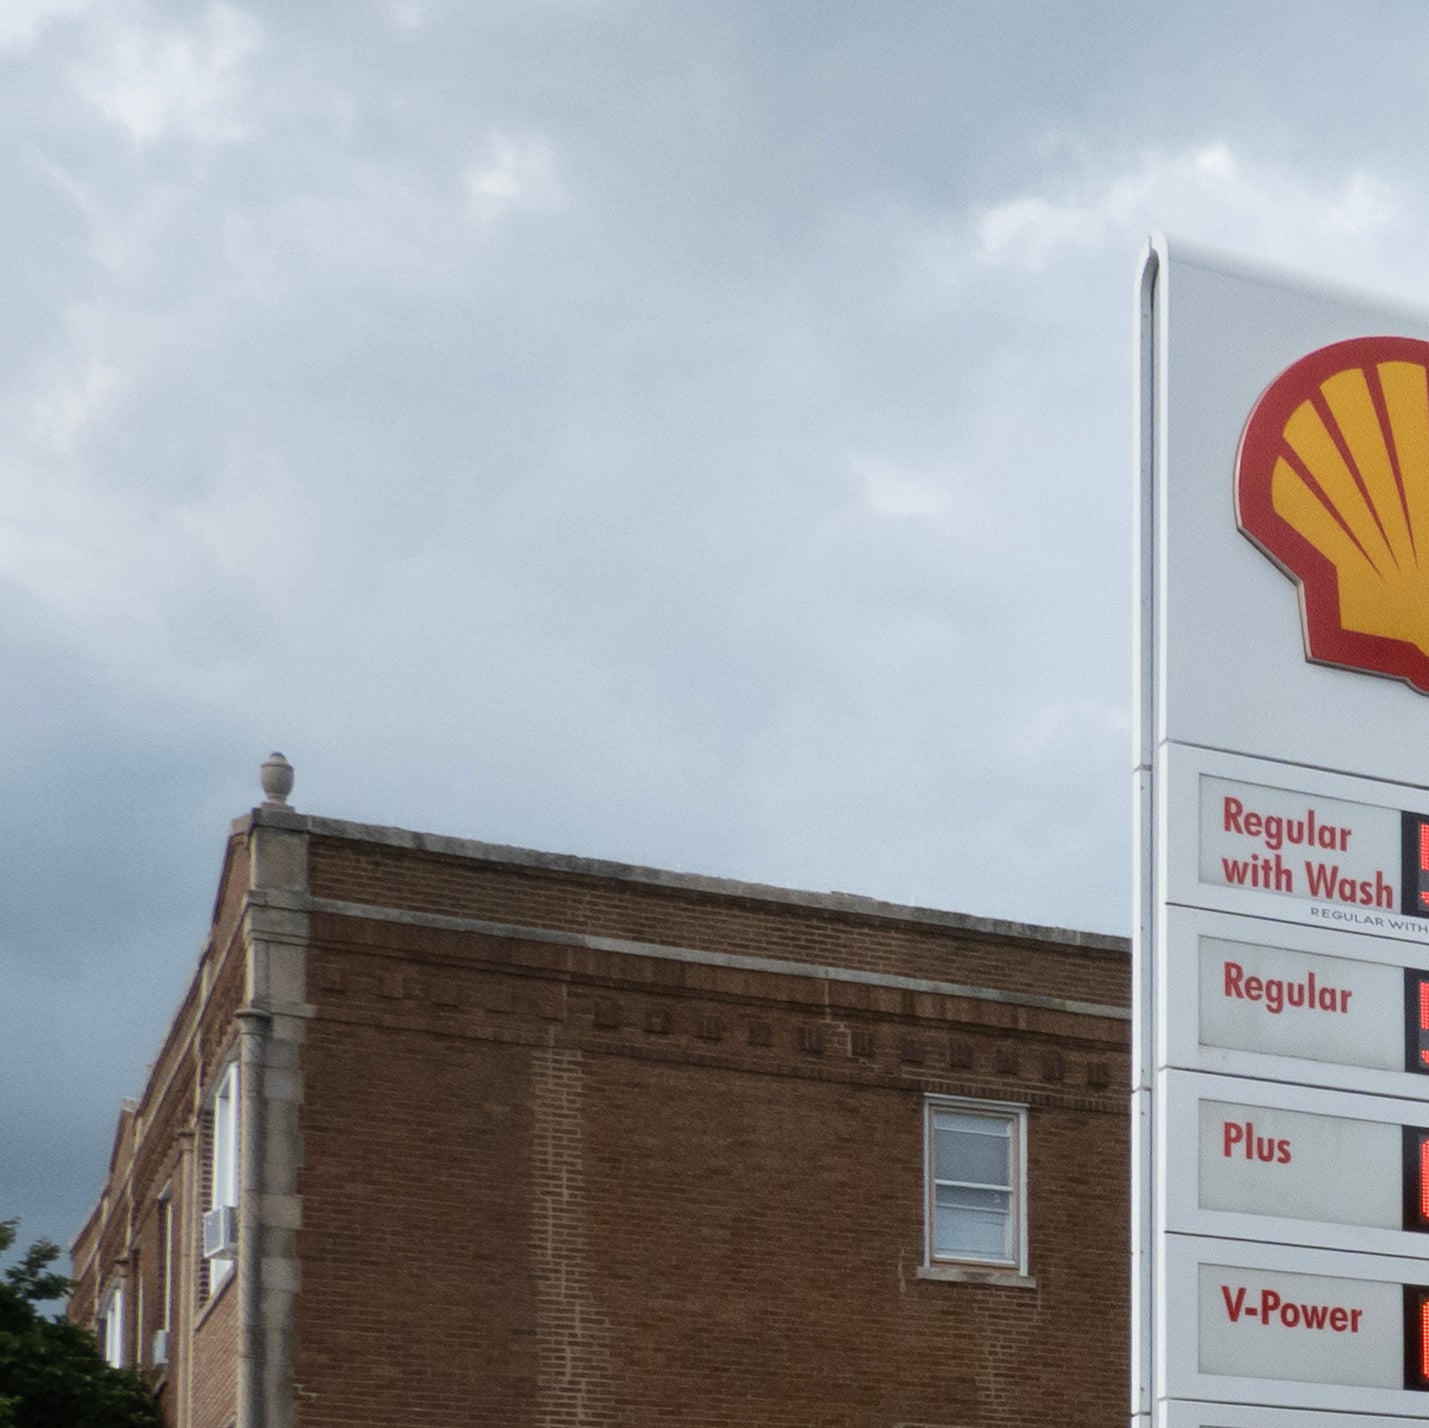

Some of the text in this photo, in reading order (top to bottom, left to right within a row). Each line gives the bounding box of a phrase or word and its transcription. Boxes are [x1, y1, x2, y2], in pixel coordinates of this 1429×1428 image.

[1222, 795, 1353, 853] Regular
[1222, 855, 1395, 911] with Wash
[1309, 906, 1385, 929] REGULAR
[1387, 918, 1429, 936] WITH
[1223, 961, 1353, 1015] Regular
[1222, 1121, 1293, 1165] Plus
[1220, 1285, 1364, 1334] V-Power
